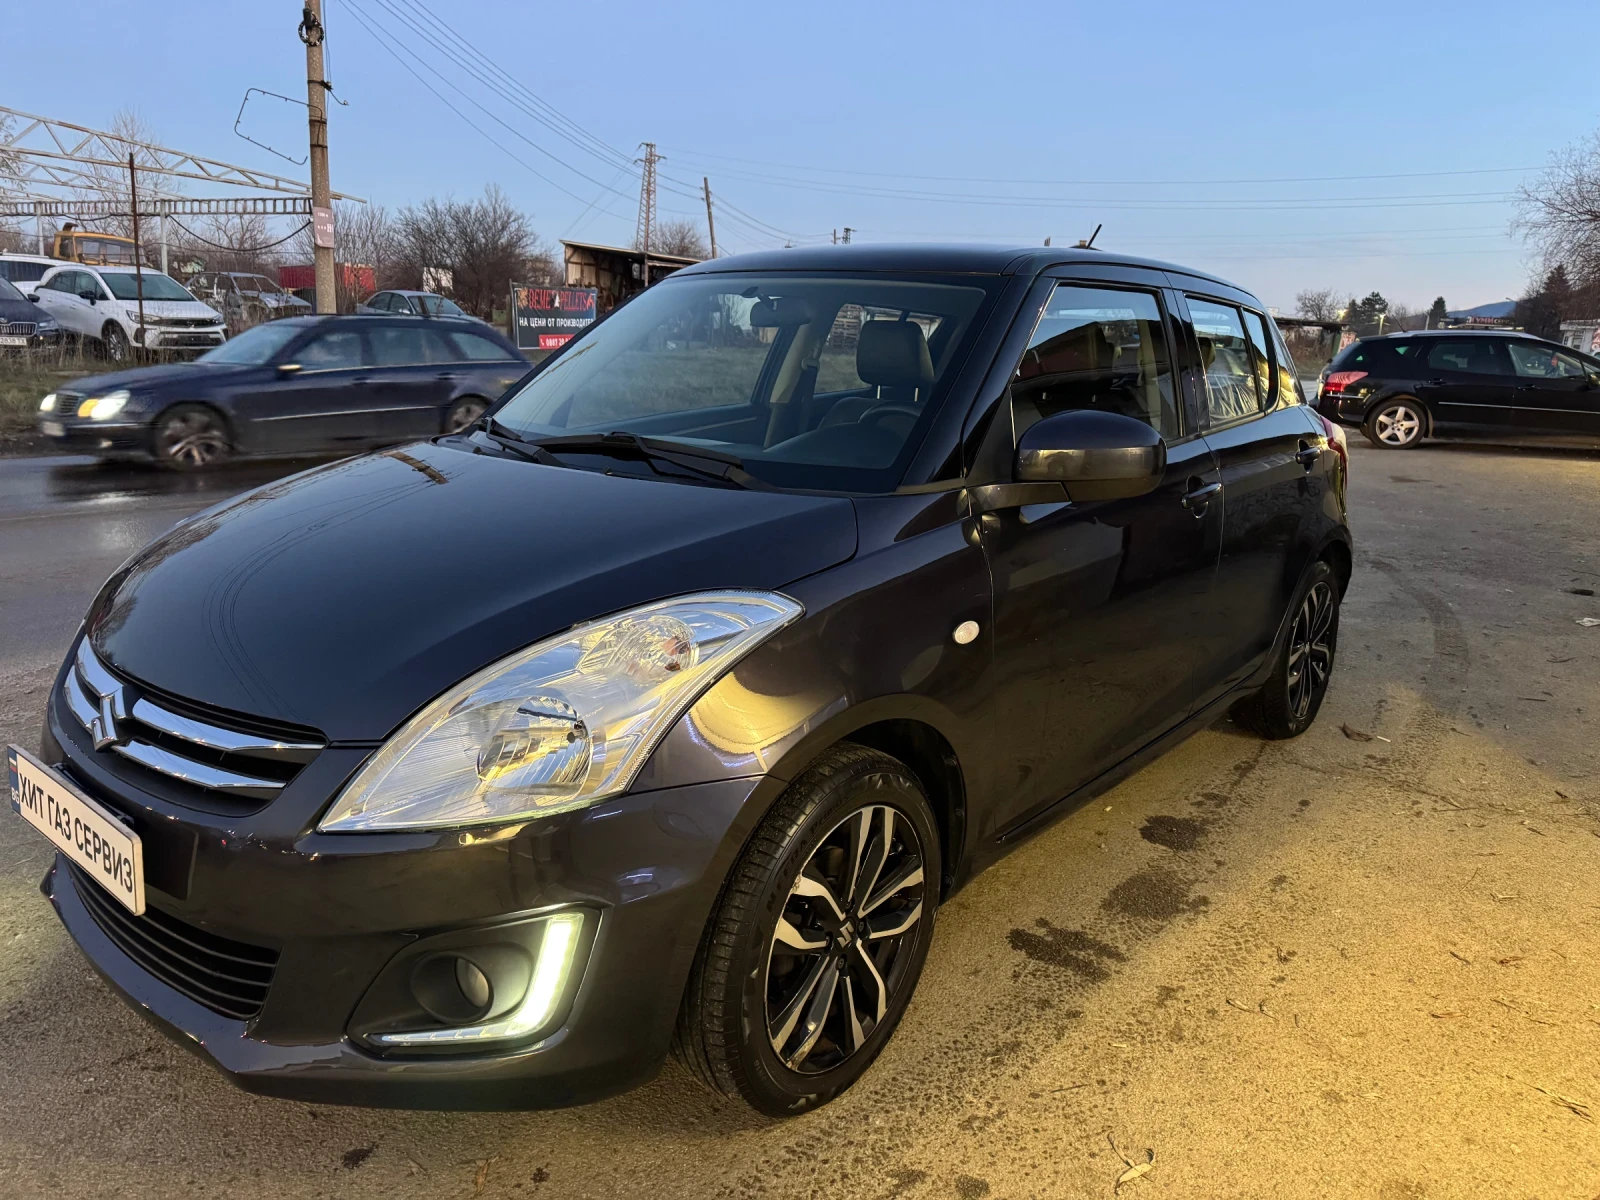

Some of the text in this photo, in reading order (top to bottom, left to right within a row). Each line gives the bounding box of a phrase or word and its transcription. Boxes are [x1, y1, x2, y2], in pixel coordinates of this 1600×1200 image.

[519, 317, 528, 327] НА
[530, 317, 546, 328] ЦЕНИ
[548, 318, 555, 327] ОТ
[11, 787, 20, 805] BG
[19, 773, 134, 893] ХИТ ГАЗ СЕРВИЗ
